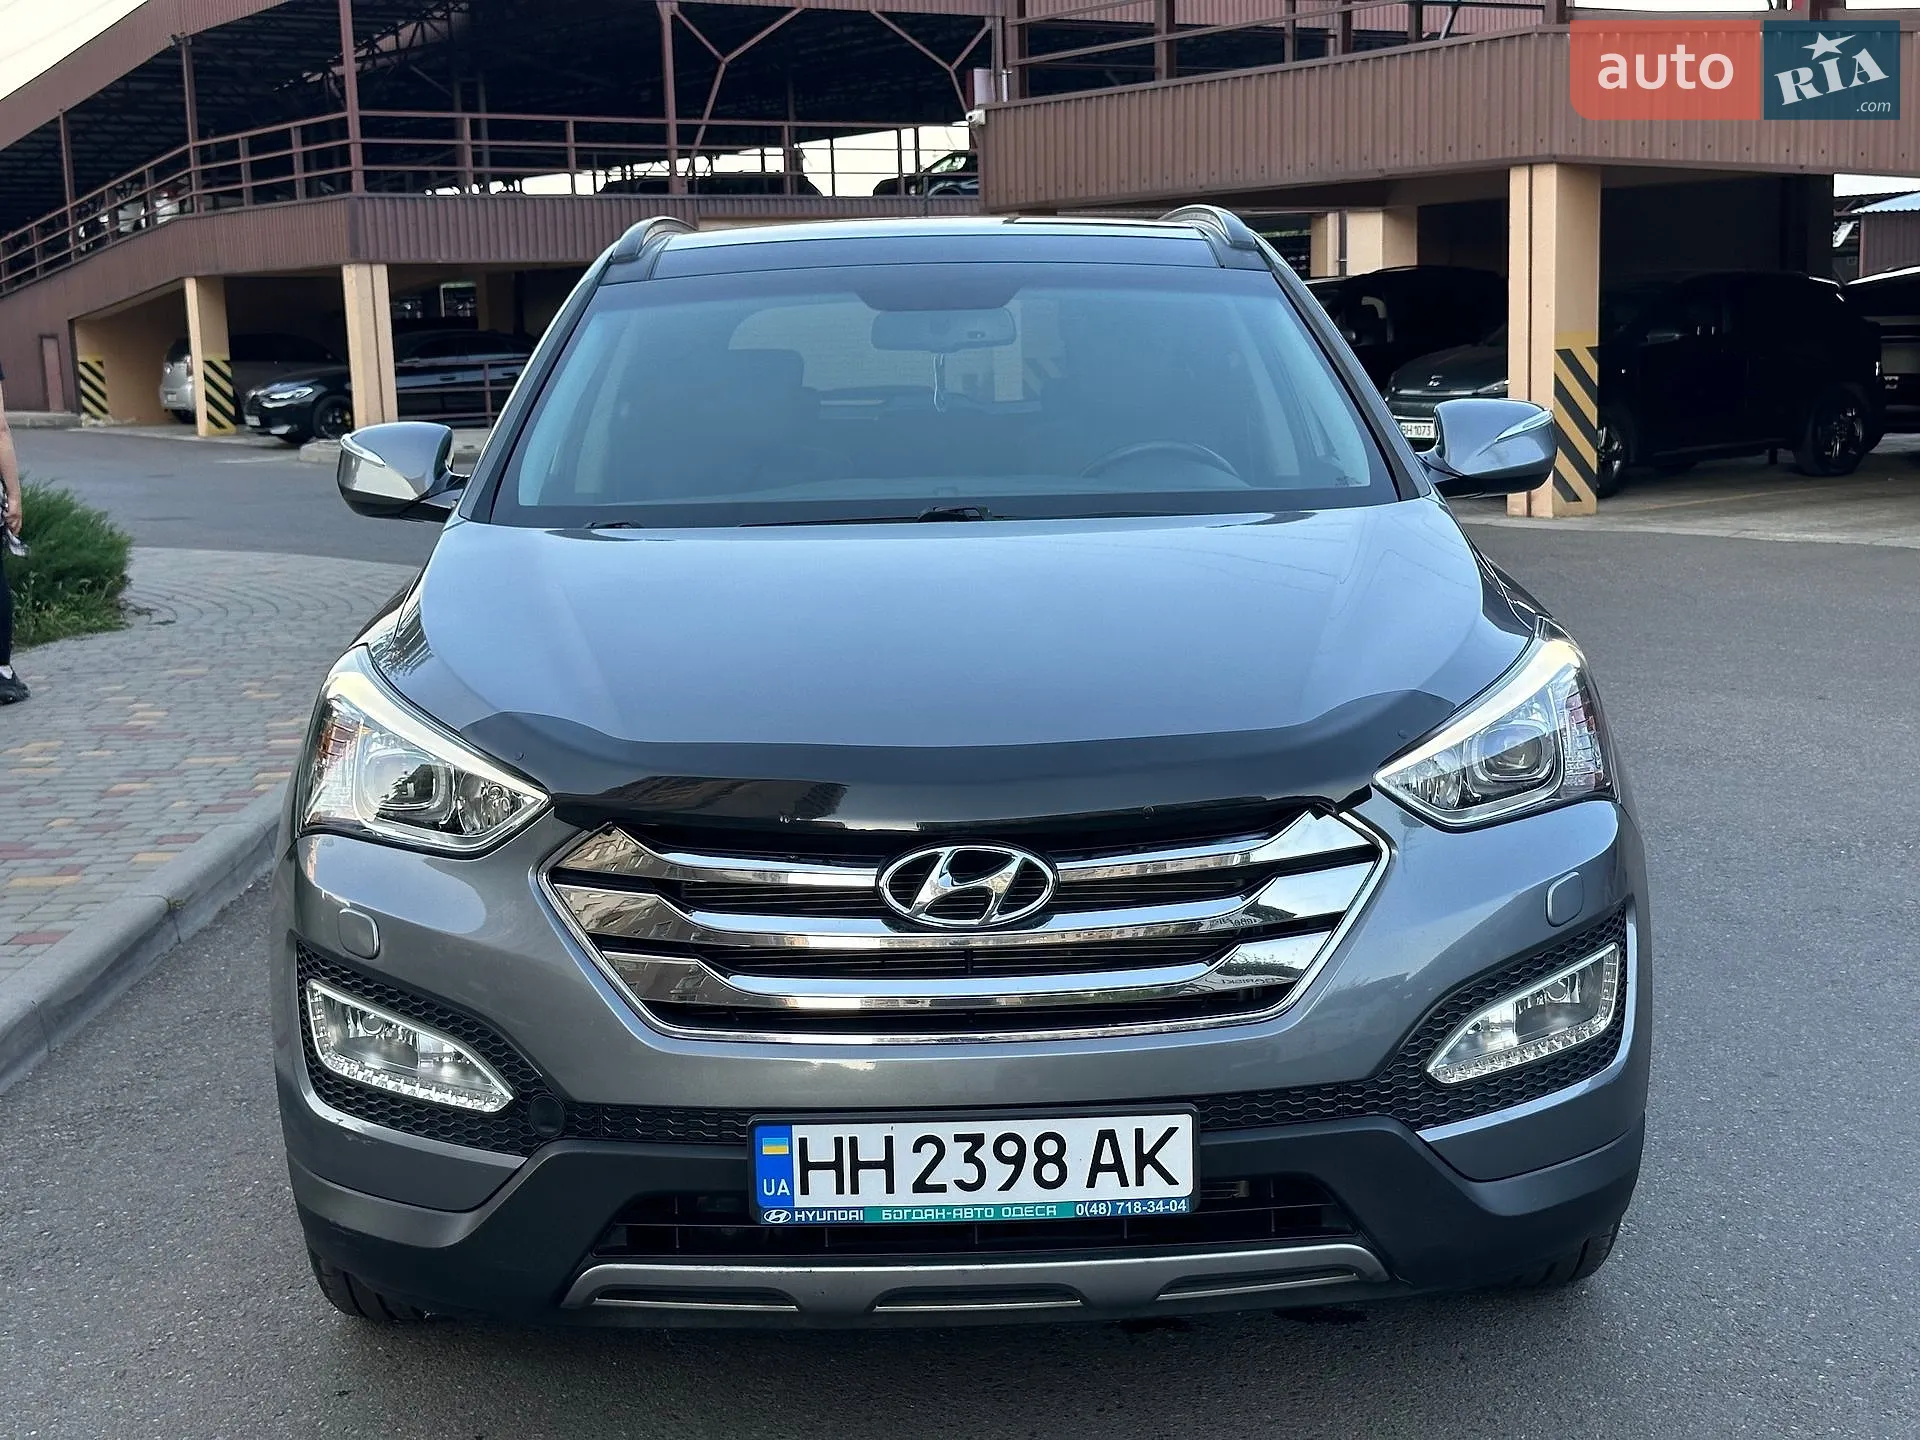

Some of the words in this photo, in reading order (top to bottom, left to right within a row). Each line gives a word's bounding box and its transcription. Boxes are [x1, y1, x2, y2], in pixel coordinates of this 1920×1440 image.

[798, 1135, 895, 1196] HH
[911, 1131, 1068, 1195] 2398
[1085, 1126, 1180, 1190] AK
[763, 1178, 790, 1196] UA
[794, 1209, 864, 1222] HYUNDAI
[881, 1206, 995, 1221] БОГДАН-АВТО
[1001, 1205, 1057, 1218] ОДЕСА
[1075, 1202, 1112, 1217] 0(48)
[1115, 1199, 1187, 1215] 718-34-04
